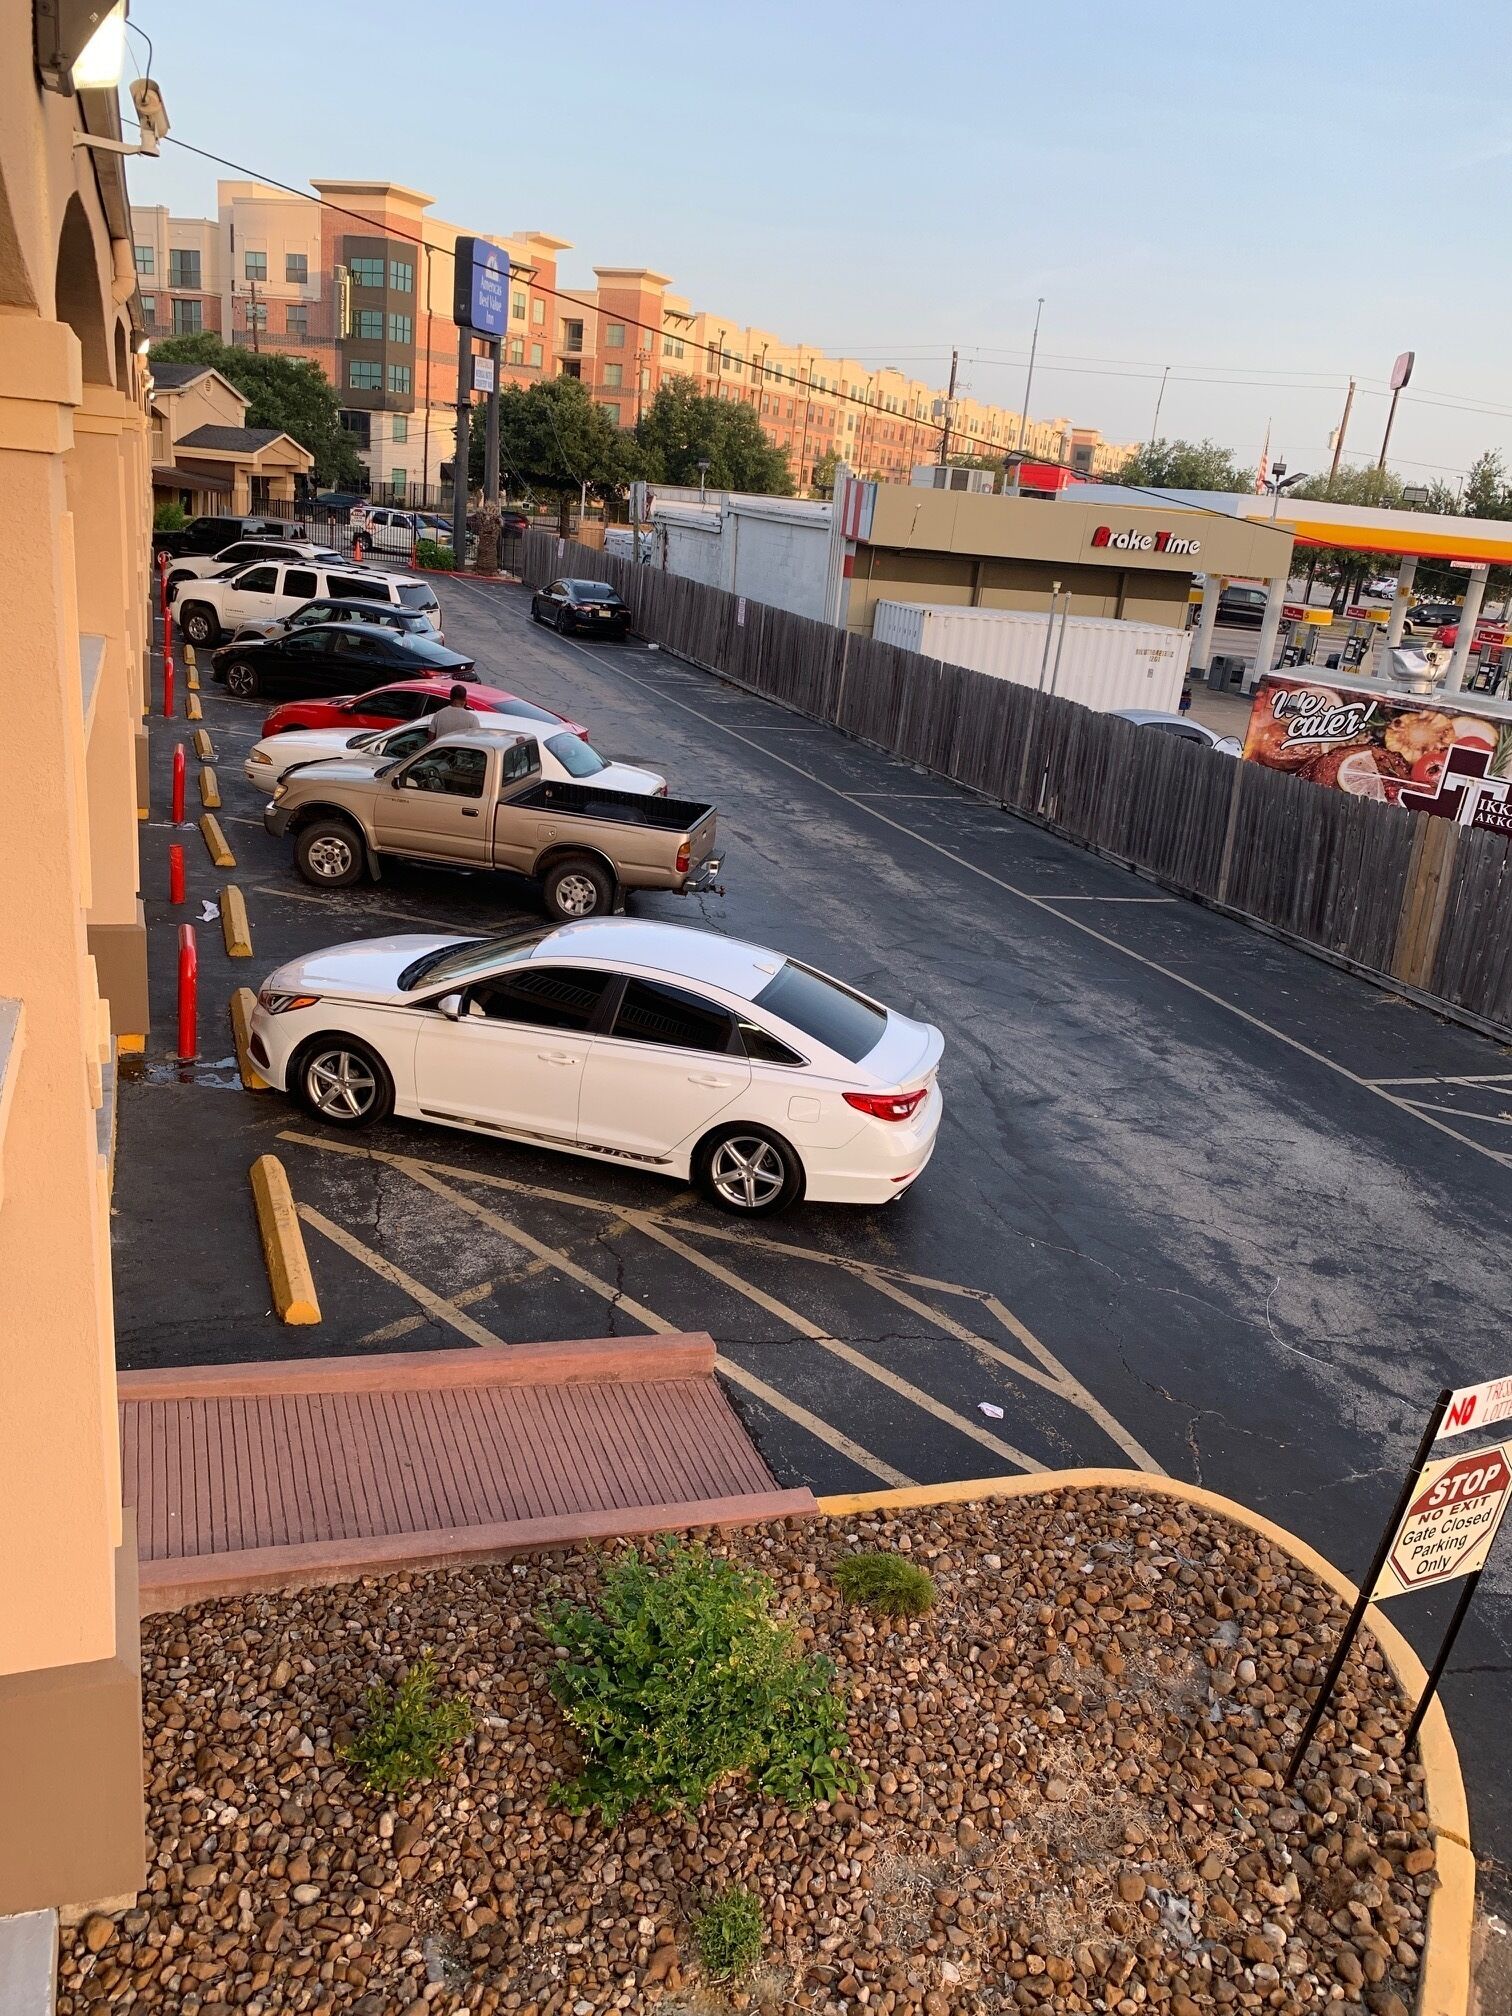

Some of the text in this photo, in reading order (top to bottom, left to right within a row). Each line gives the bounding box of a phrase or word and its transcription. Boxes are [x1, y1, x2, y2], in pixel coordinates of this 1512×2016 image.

[479, 290, 502, 313] Best Value
[485, 310, 495, 325] Inn
[1091, 526, 1201, 555] Brake Time
[1287, 700, 1379, 738] cater!
[1444, 1395, 1477, 1431] NO
[1428, 1463, 1502, 1506] STOP
[1417, 1495, 1491, 1526] NO EXIT
[1402, 1507, 1493, 1546] Gate Closed
[1410, 1534, 1468, 1561] Parking
[1416, 1555, 1452, 1576] Only
